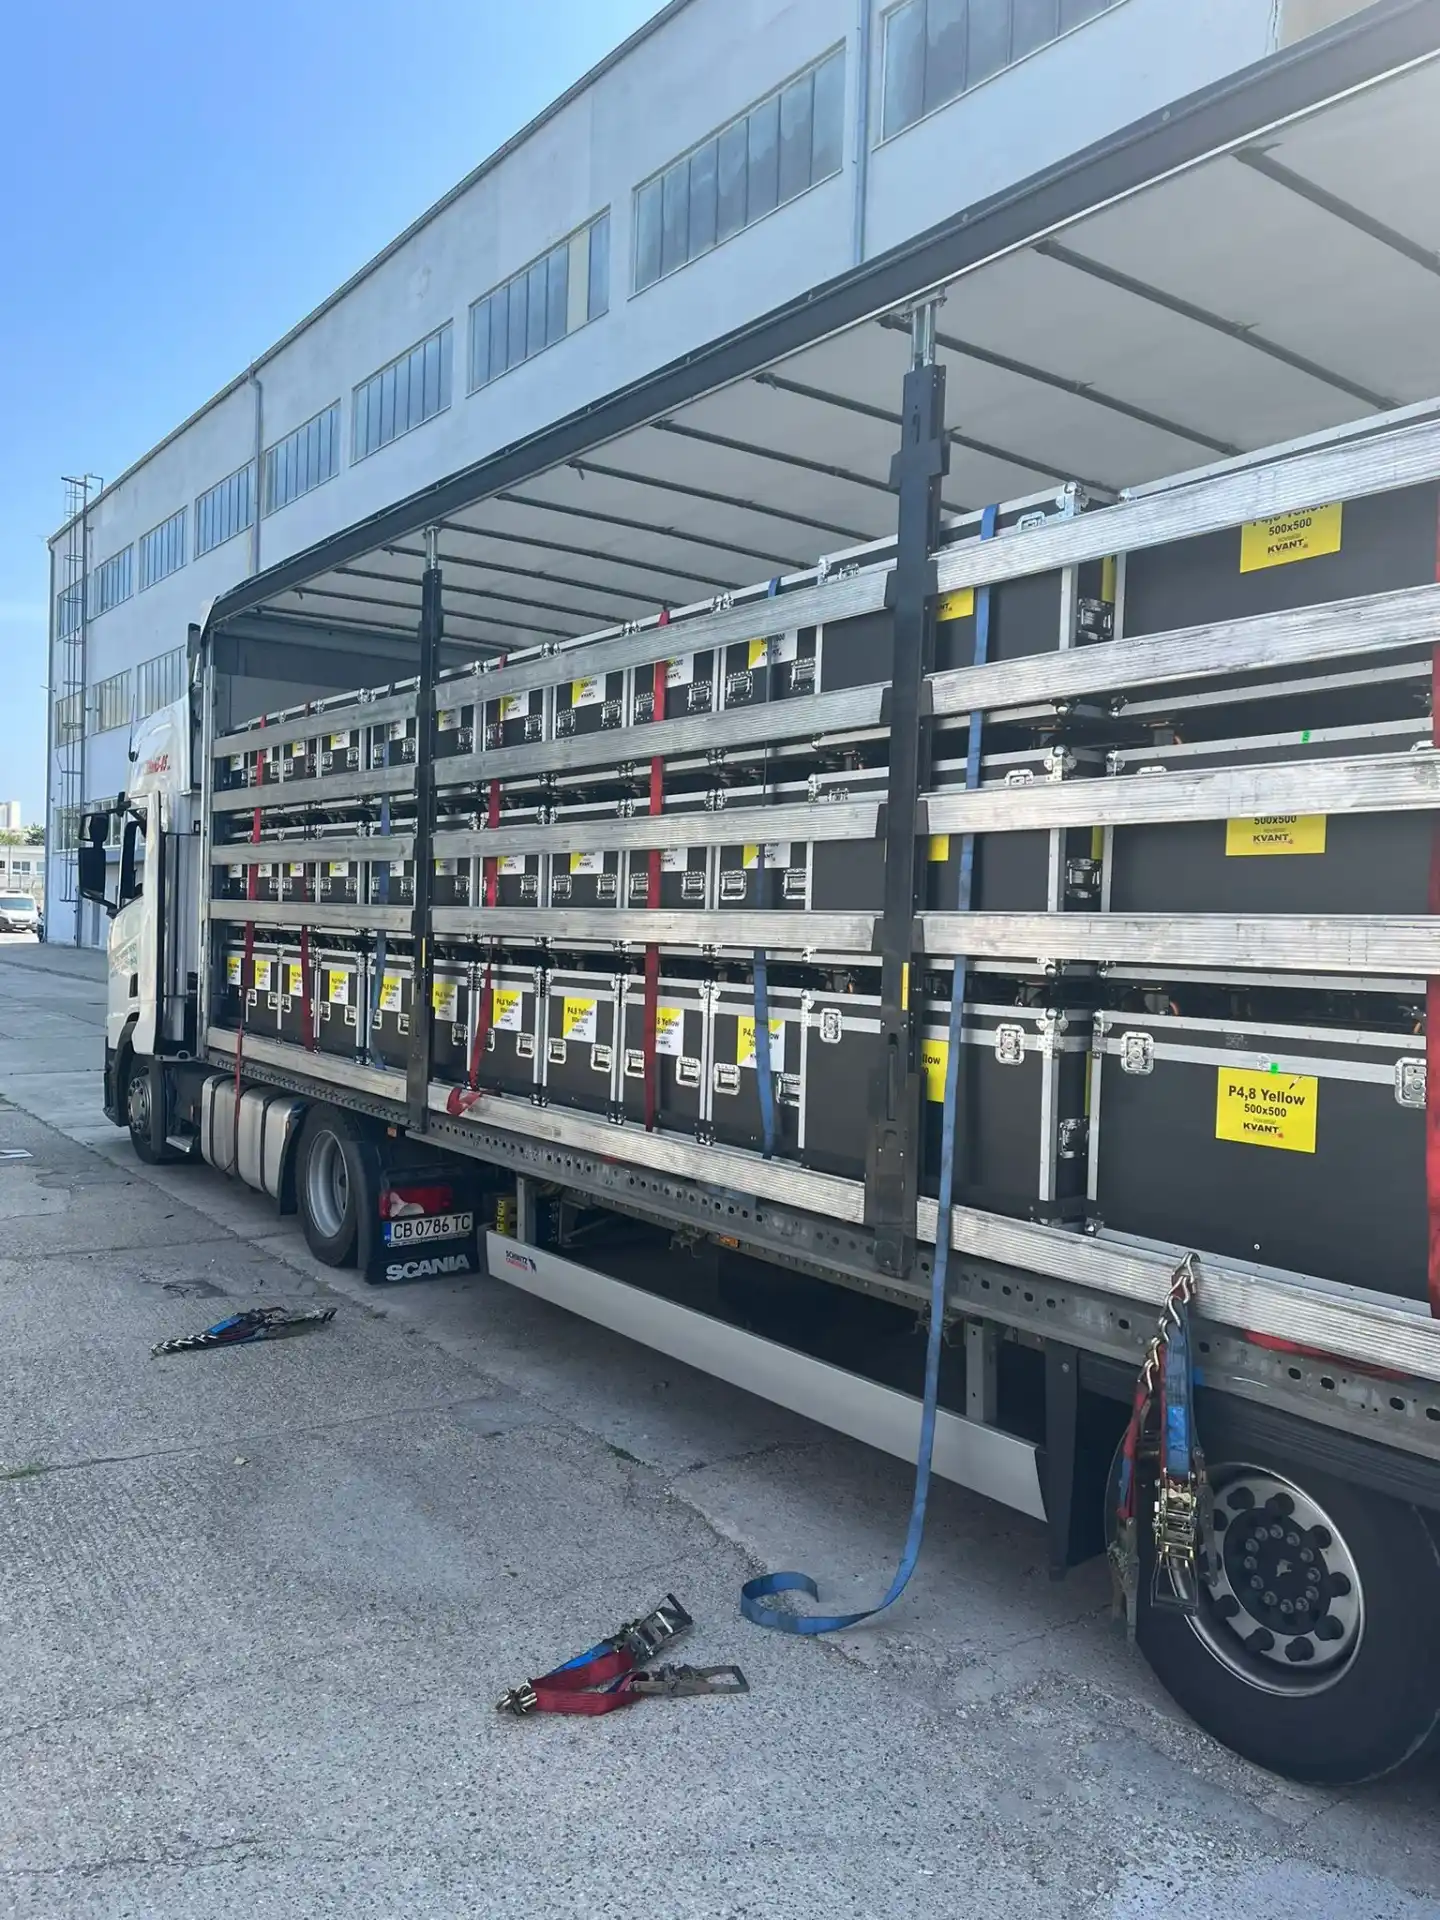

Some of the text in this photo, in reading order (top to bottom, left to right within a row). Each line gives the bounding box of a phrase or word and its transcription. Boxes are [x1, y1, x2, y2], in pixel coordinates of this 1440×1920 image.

[1268, 517, 1312, 536] 500x500
[1267, 538, 1304, 554] KVANT
[1253, 833, 1289, 842] KVANT
[1228, 1085, 1305, 1106] P4,8 Yellow
[1244, 1103, 1287, 1117] 500x500
[1243, 1122, 1279, 1134] KVANT
[394, 1215, 471, 1239] CB 0786 TC
[386, 1253, 470, 1281] SCANIA
